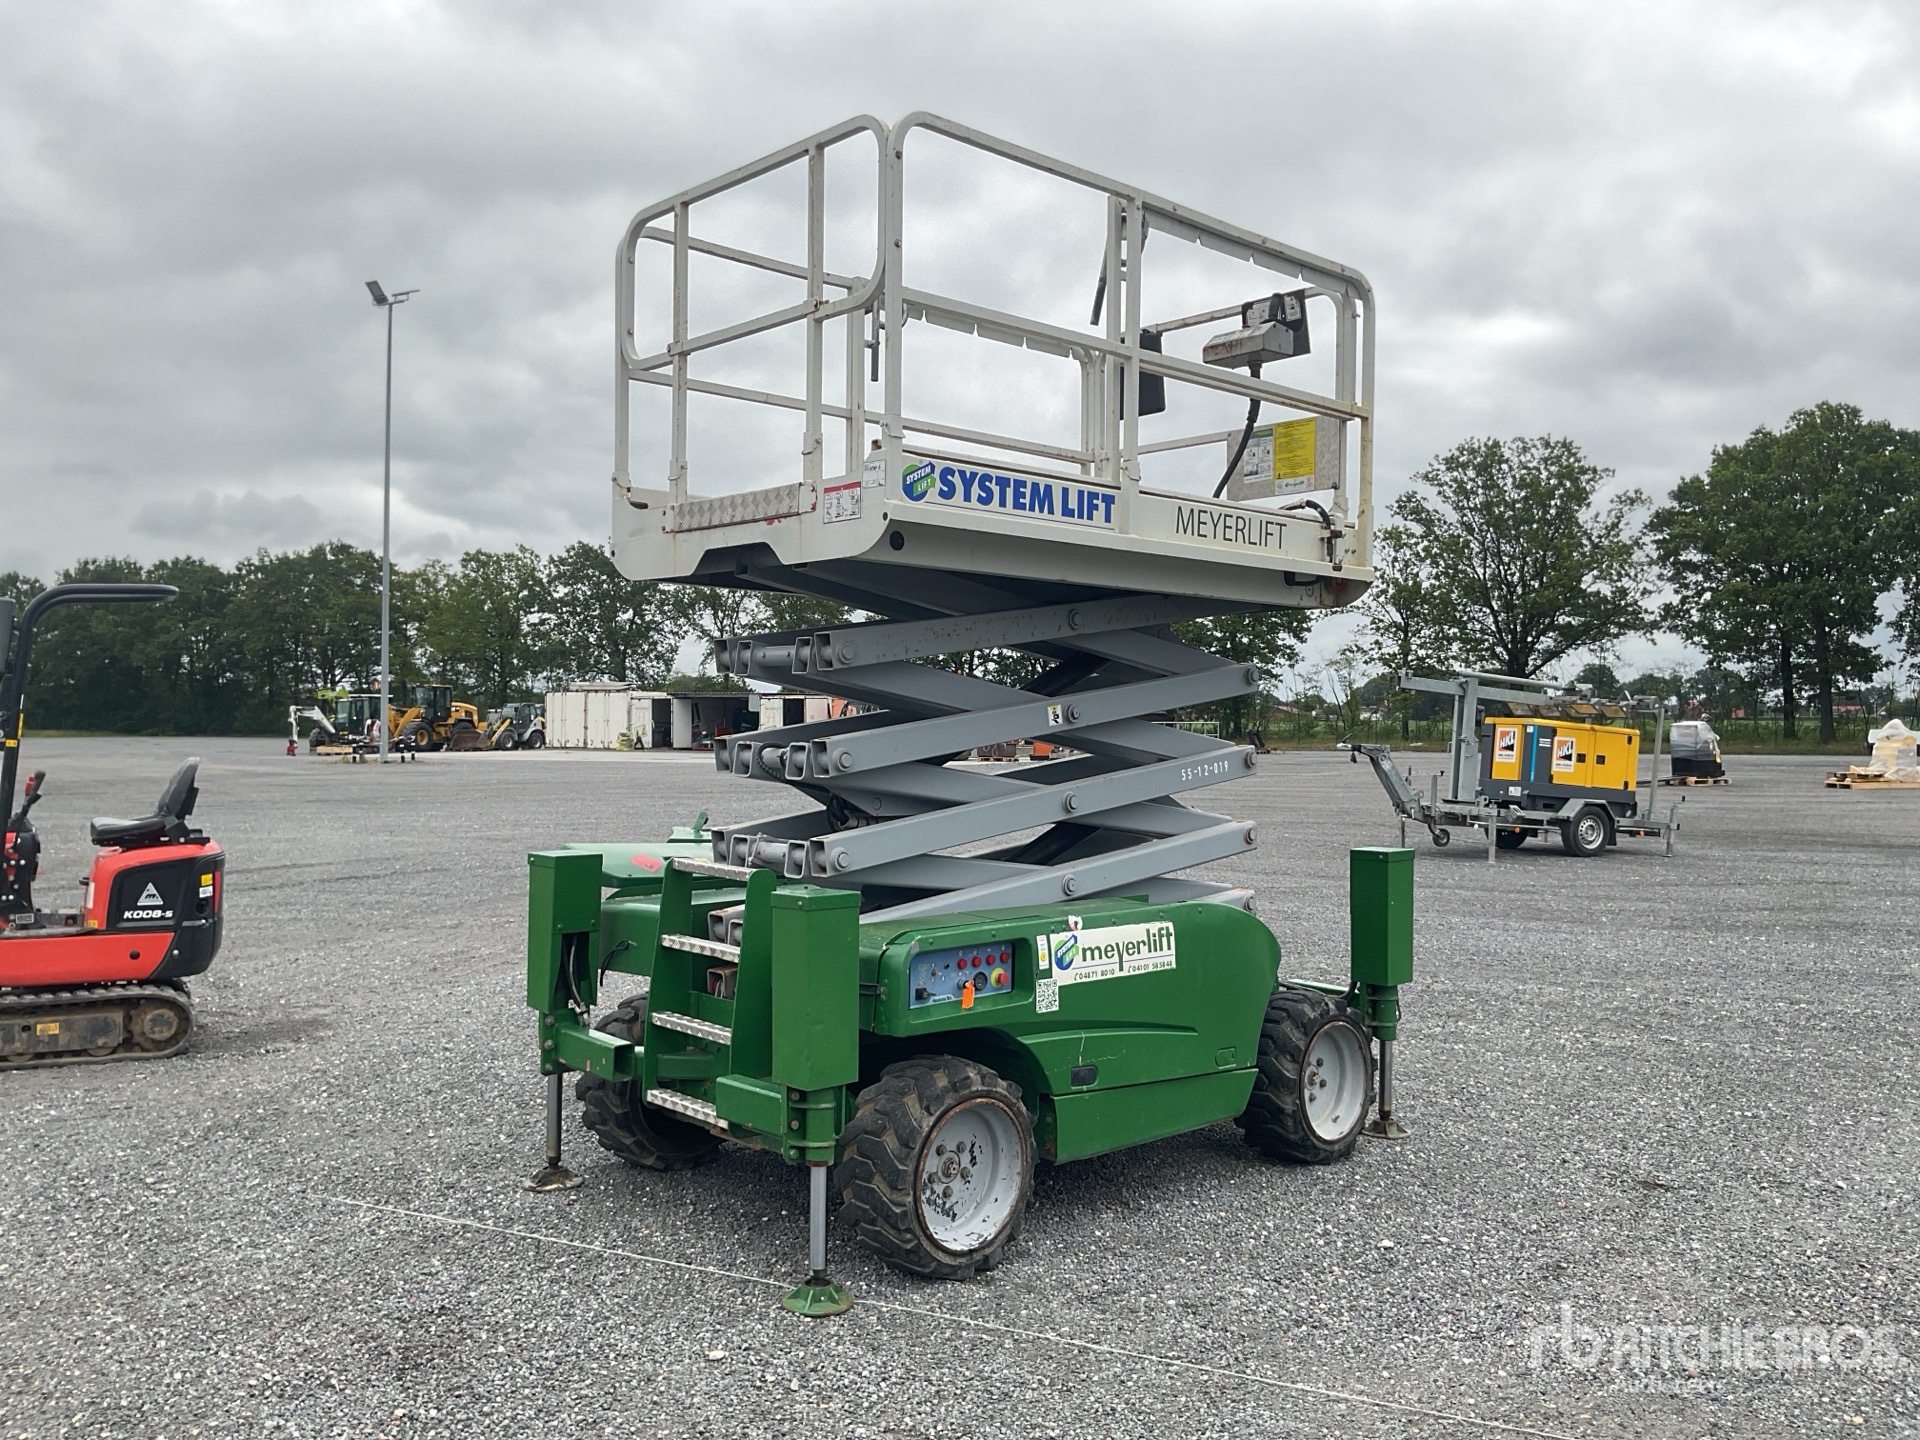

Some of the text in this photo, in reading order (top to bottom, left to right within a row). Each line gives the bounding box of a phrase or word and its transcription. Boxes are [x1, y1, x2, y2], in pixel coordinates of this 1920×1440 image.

[906, 465, 931, 484] SYSTEM
[918, 479, 931, 491] LIFT
[938, 466, 1116, 524] SYSTEM LIFT
[1176, 505, 1287, 549] MEYERLIFT
[1181, 760, 1229, 781] 55-12-019
[1082, 926, 1173, 972] meyerlift
[1101, 969, 1115, 977] 8010
